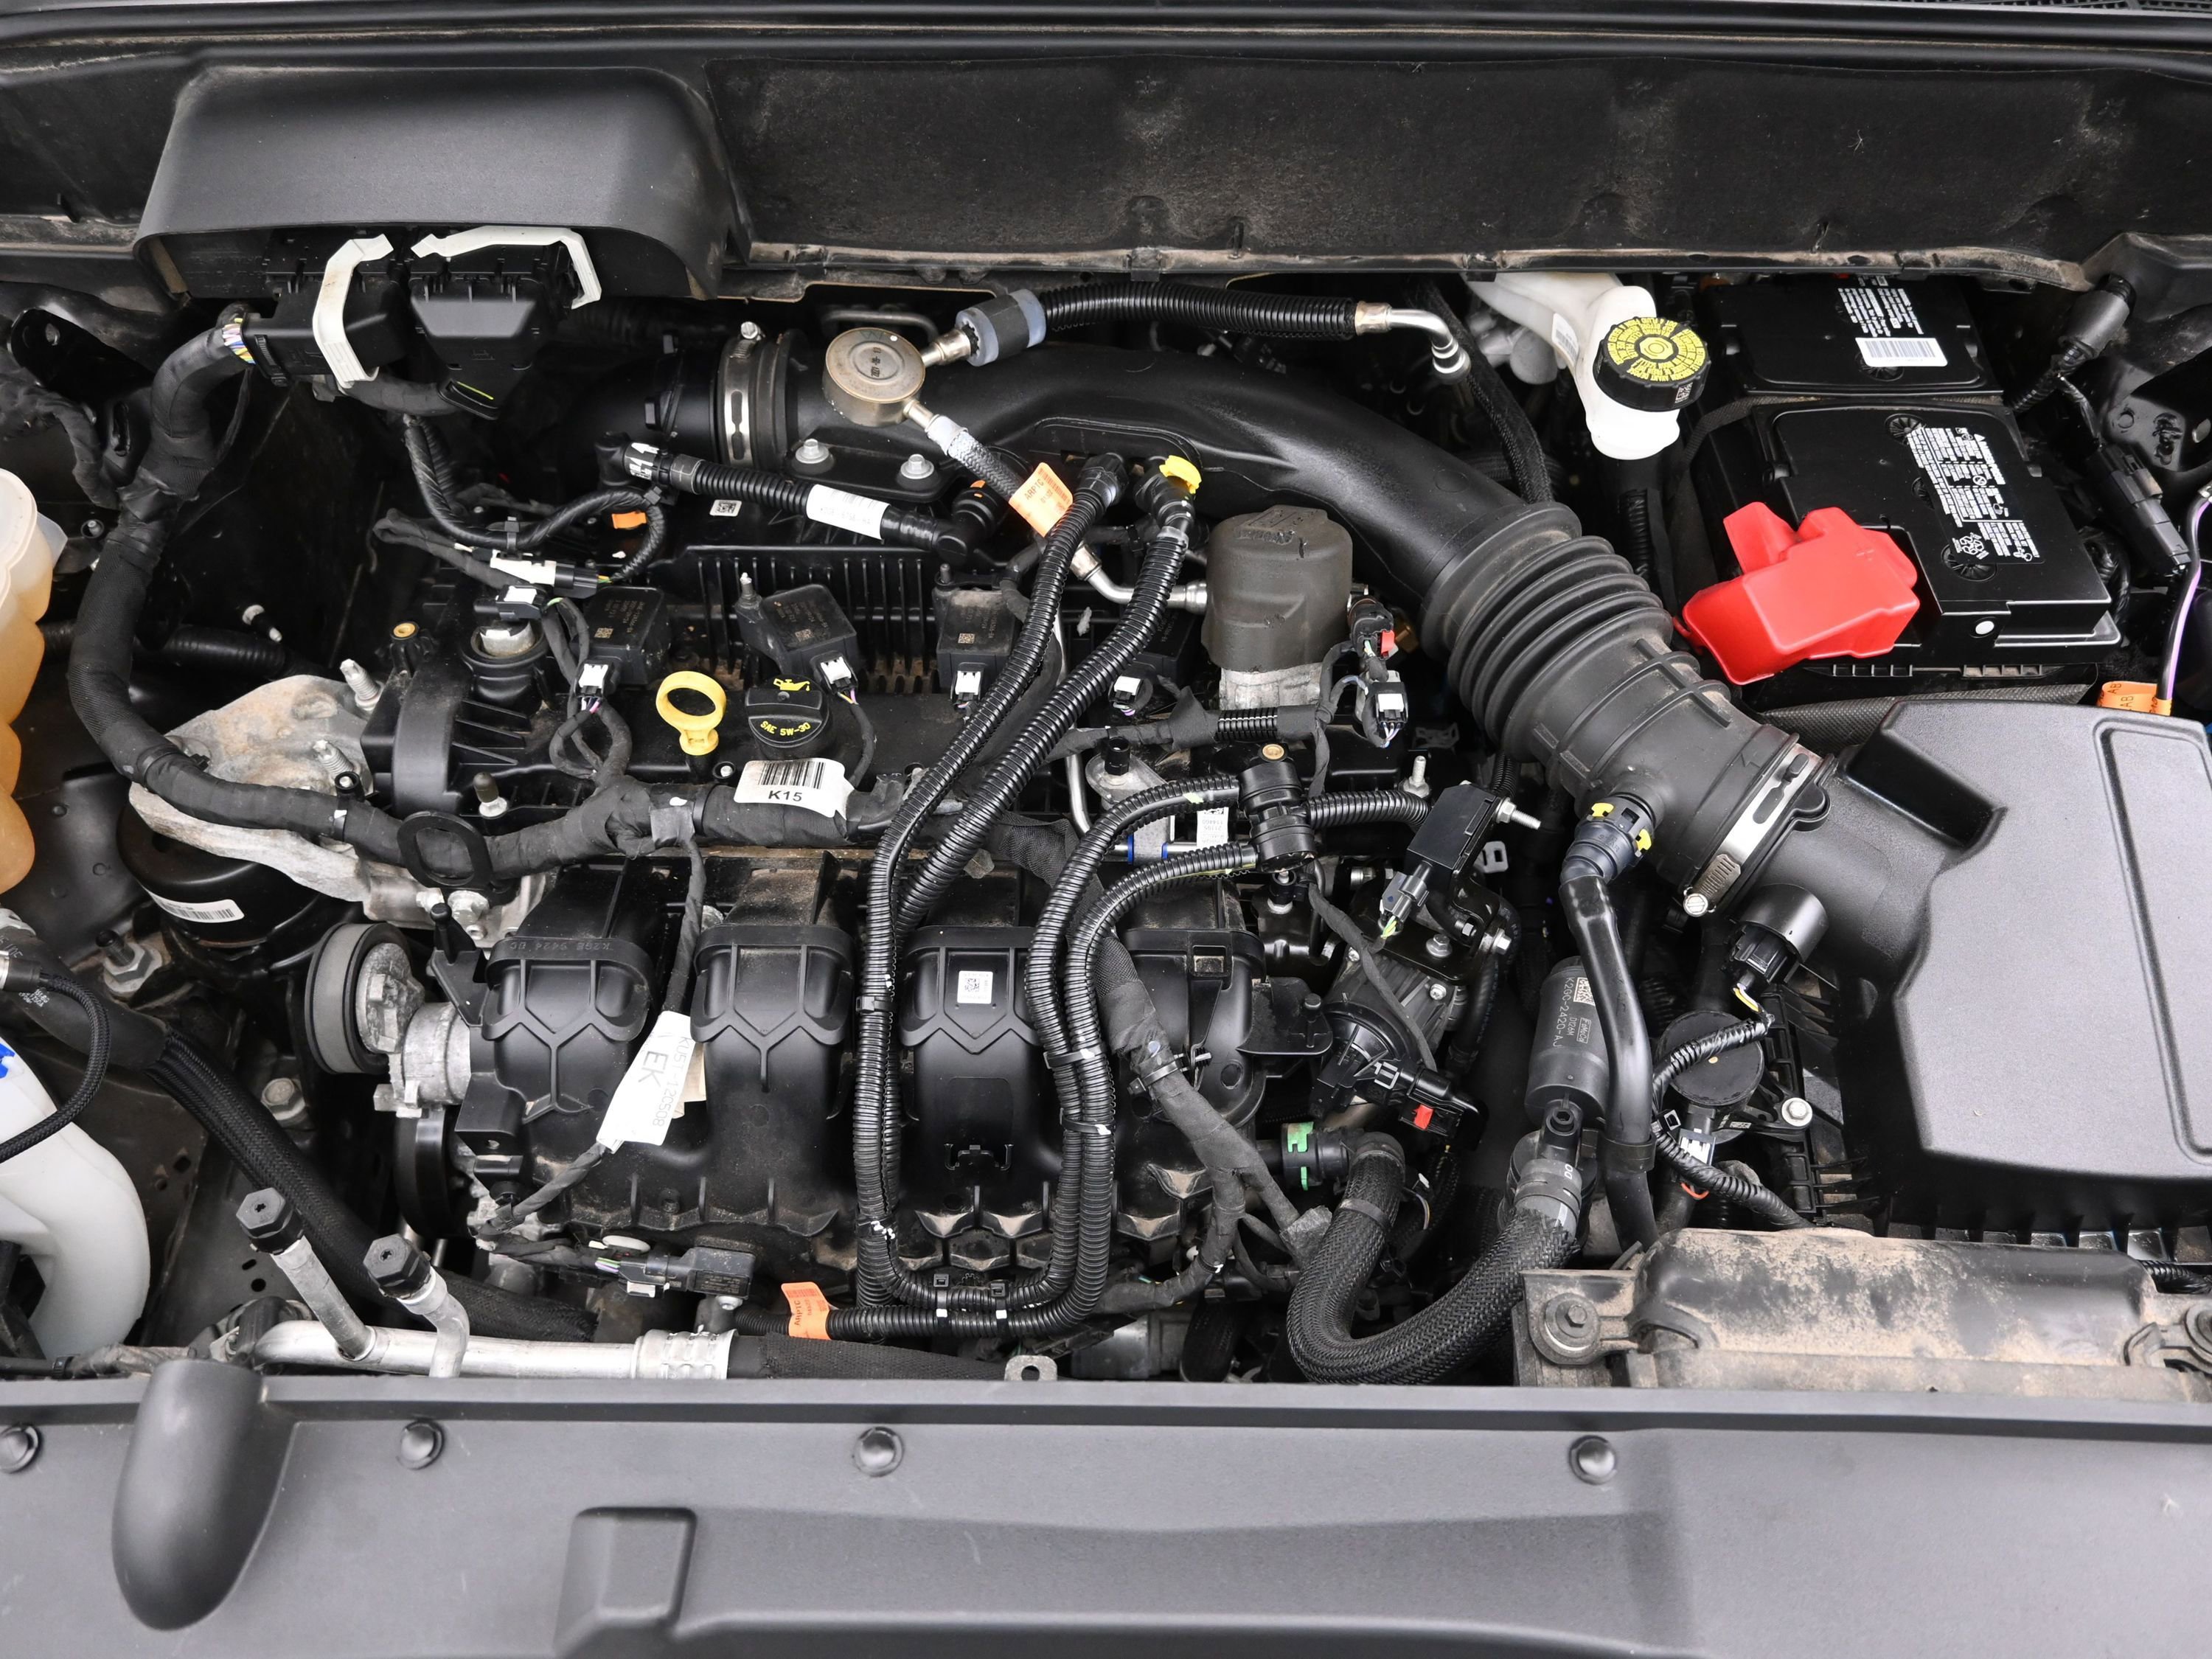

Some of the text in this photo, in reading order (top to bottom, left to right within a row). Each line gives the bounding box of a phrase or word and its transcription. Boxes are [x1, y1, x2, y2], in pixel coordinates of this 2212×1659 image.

[2107, 683, 2122, 695] AB
[2120, 695, 2134, 708] AB
[760, 720, 812, 737] SAE 5W-30
[768, 790, 803, 802] K15
[638, 1050, 669, 1087] EK
